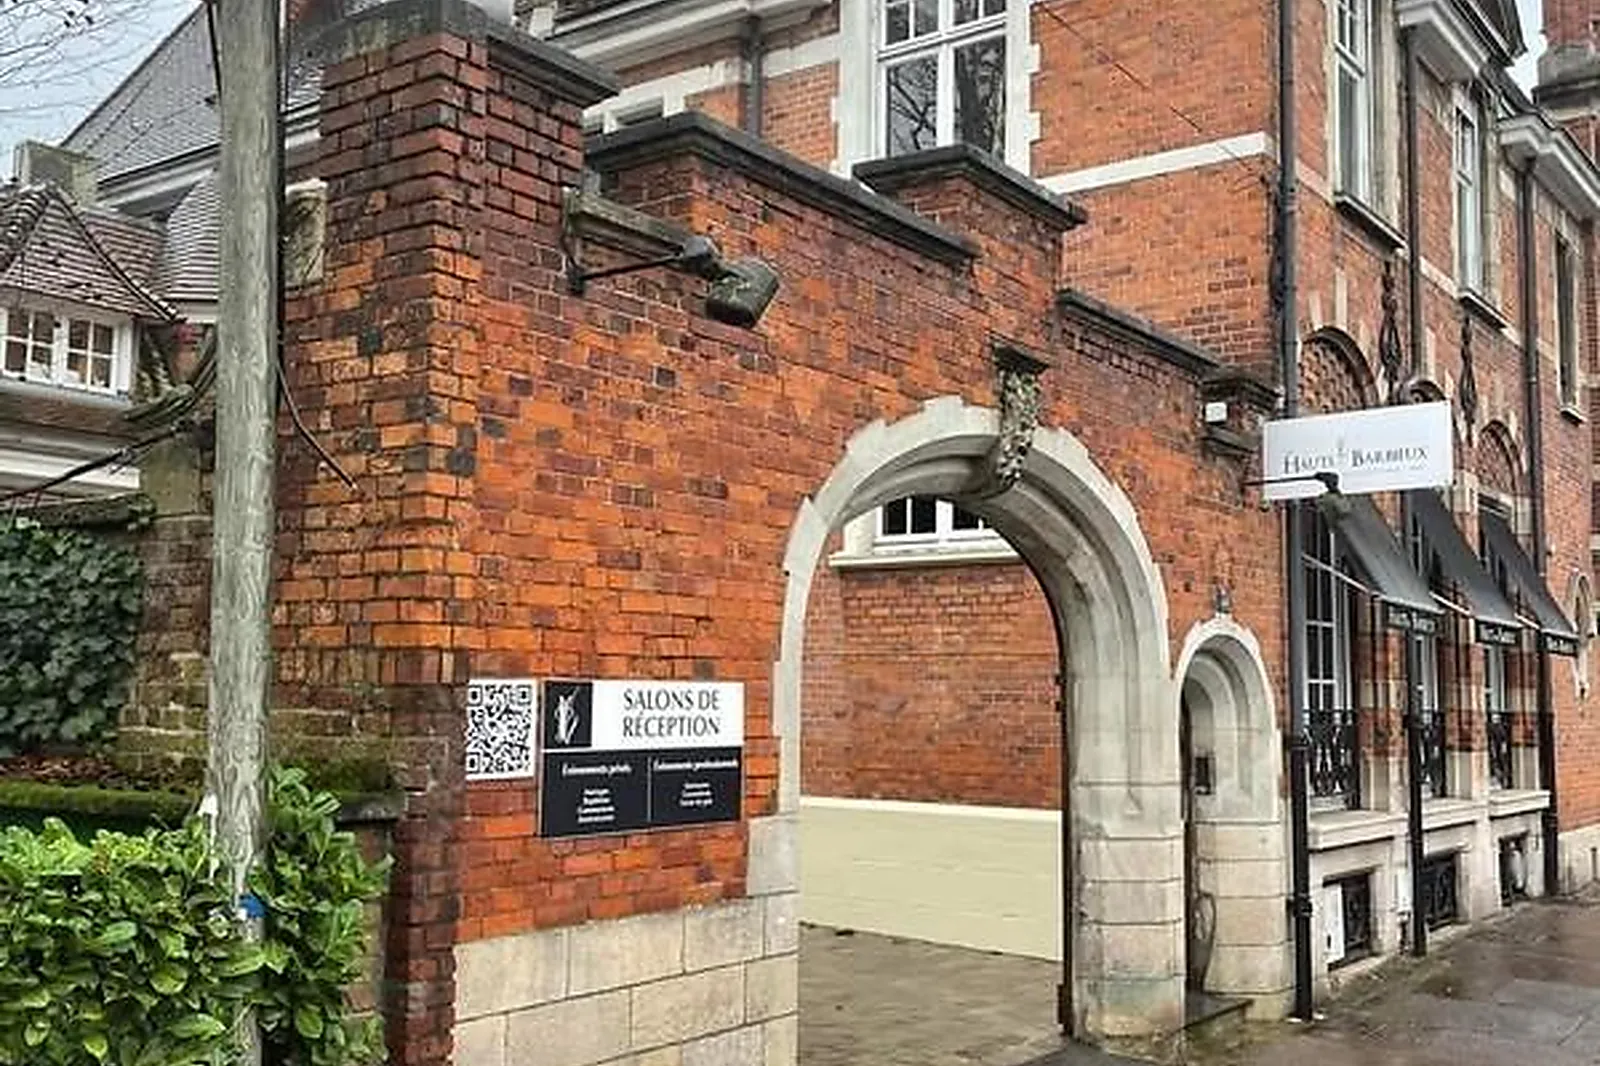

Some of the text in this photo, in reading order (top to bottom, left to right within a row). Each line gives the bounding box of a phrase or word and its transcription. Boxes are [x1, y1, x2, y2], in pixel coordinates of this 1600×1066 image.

[623, 688, 721, 710] SALONS DE
[622, 712, 721, 737] RÉCEPTION
